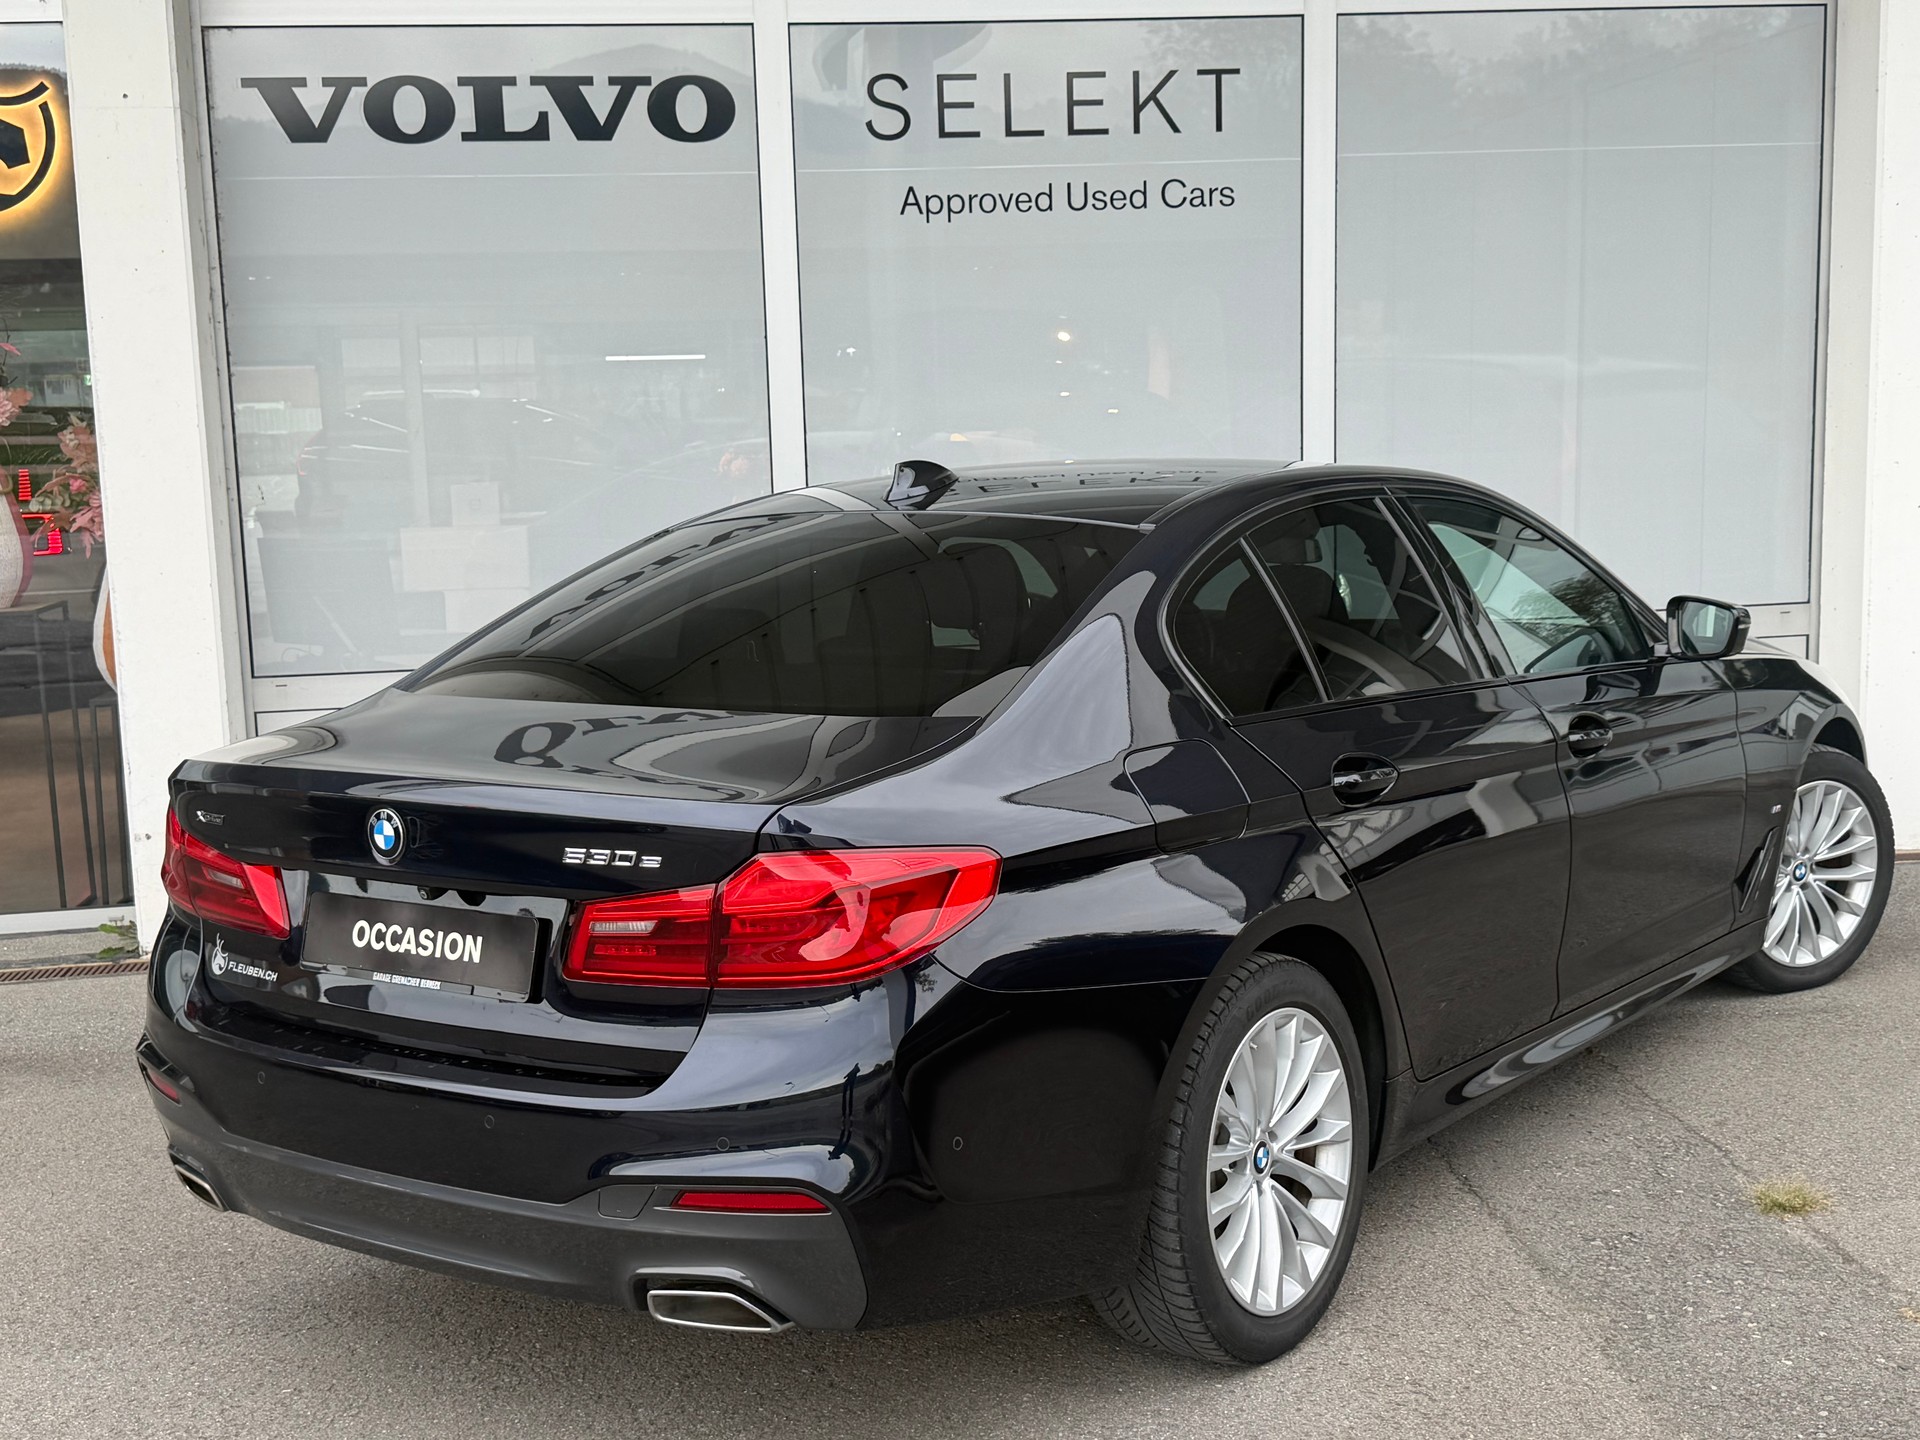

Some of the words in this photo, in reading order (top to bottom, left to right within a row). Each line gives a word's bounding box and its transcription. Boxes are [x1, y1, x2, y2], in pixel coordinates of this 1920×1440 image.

[240, 74, 736, 144] VOLVO
[865, 68, 1241, 141] SELEKT
[900, 182, 1053, 223] Approved
[1066, 180, 1149, 212] Used
[1160, 178, 1236, 209] Cars
[352, 919, 483, 963] OCCASION
[227, 961, 279, 982] FLEUBEN.CH
[373, 972, 391, 982] GARAGE
